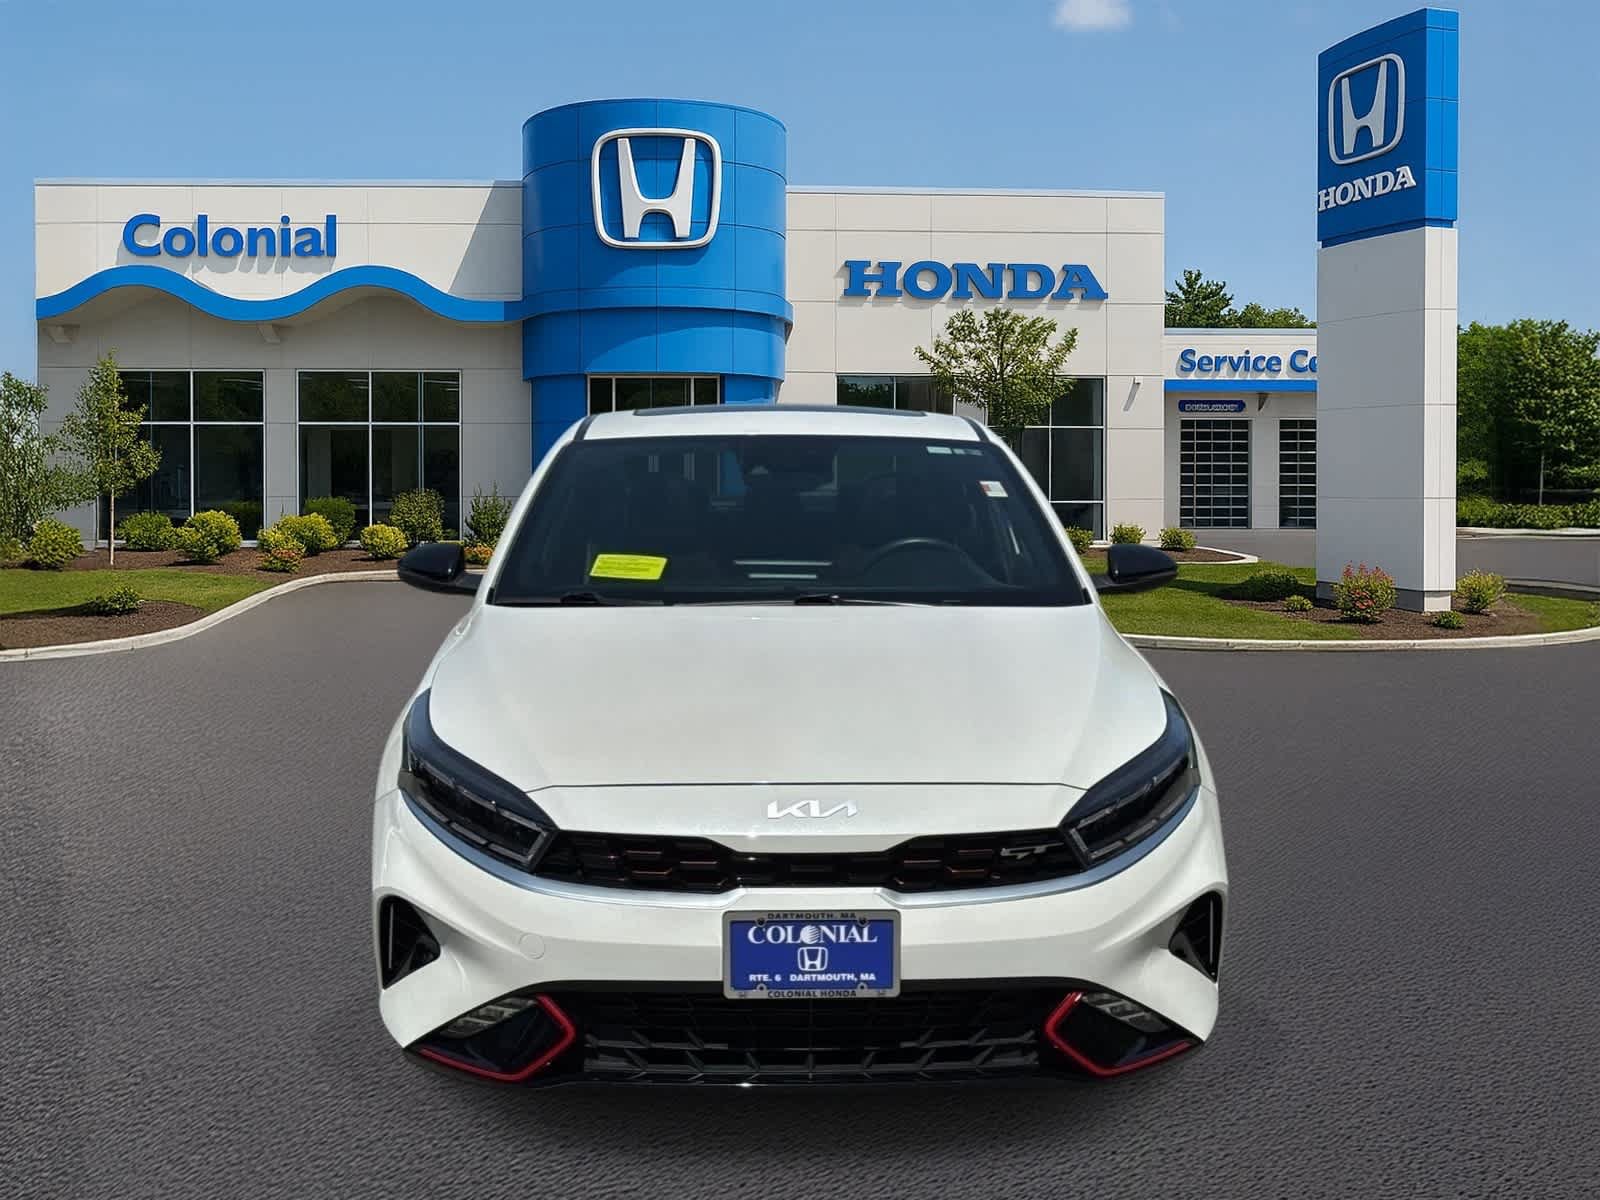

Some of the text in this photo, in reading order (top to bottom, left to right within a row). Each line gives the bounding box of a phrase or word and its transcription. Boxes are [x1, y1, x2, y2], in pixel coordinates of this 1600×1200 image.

[1318, 166, 1417, 212] HONDA
[123, 213, 337, 257] Colonial
[843, 260, 1109, 300] HONDA
[1180, 348, 1282, 373] Service
[841, 912, 857, 920] MA
[748, 925, 878, 944] COLONIAL
[749, 973, 876, 983] RTE. 6 DARTMOUTH, MA
[767, 990, 857, 998] COLONIAL HONDA
